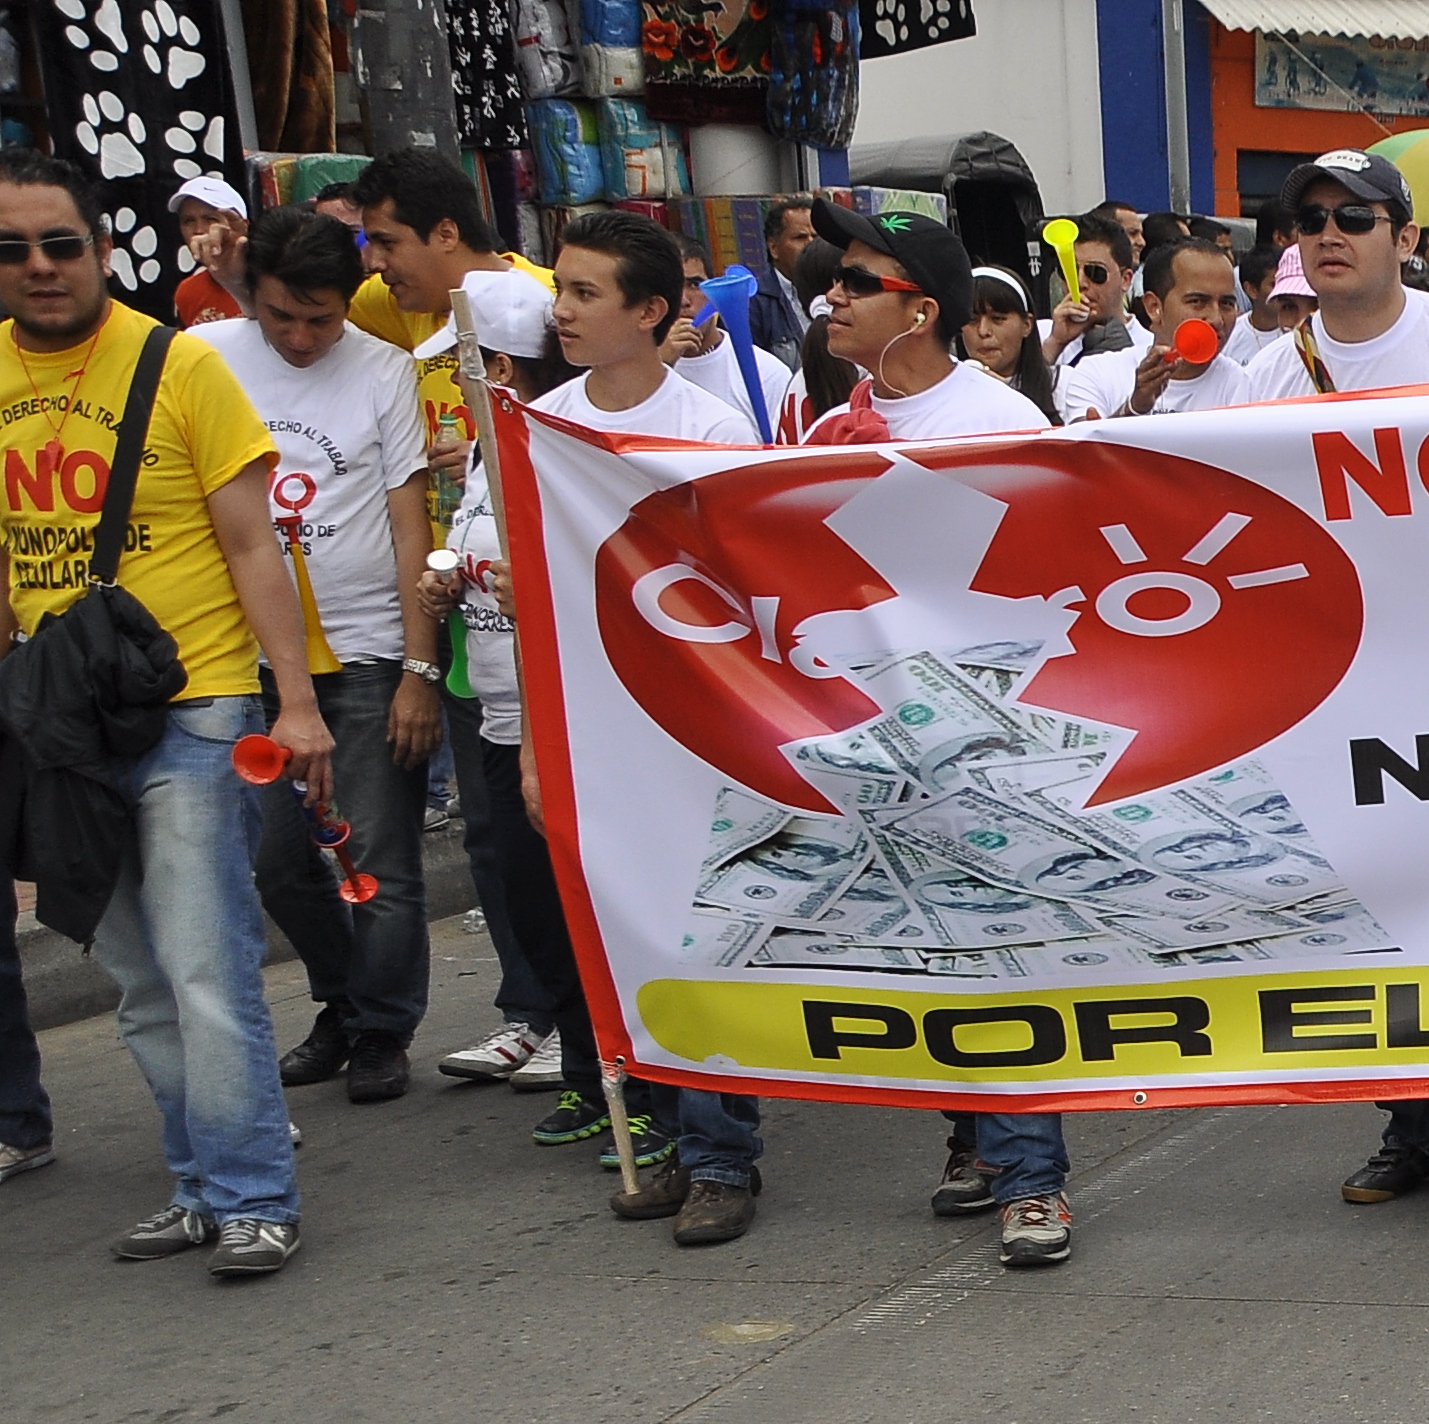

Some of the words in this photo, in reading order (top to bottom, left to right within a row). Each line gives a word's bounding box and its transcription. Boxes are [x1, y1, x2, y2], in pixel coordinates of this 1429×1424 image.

[2, 394, 70, 425] DERECHO
[72, 399, 91, 419] AL
[317, 435, 348, 476] TRABAJO
[5, 449, 112, 514] NO
[124, 524, 152, 552] DE
[317, 525, 336, 538] DE
[802, 996, 1212, 1069] POR
